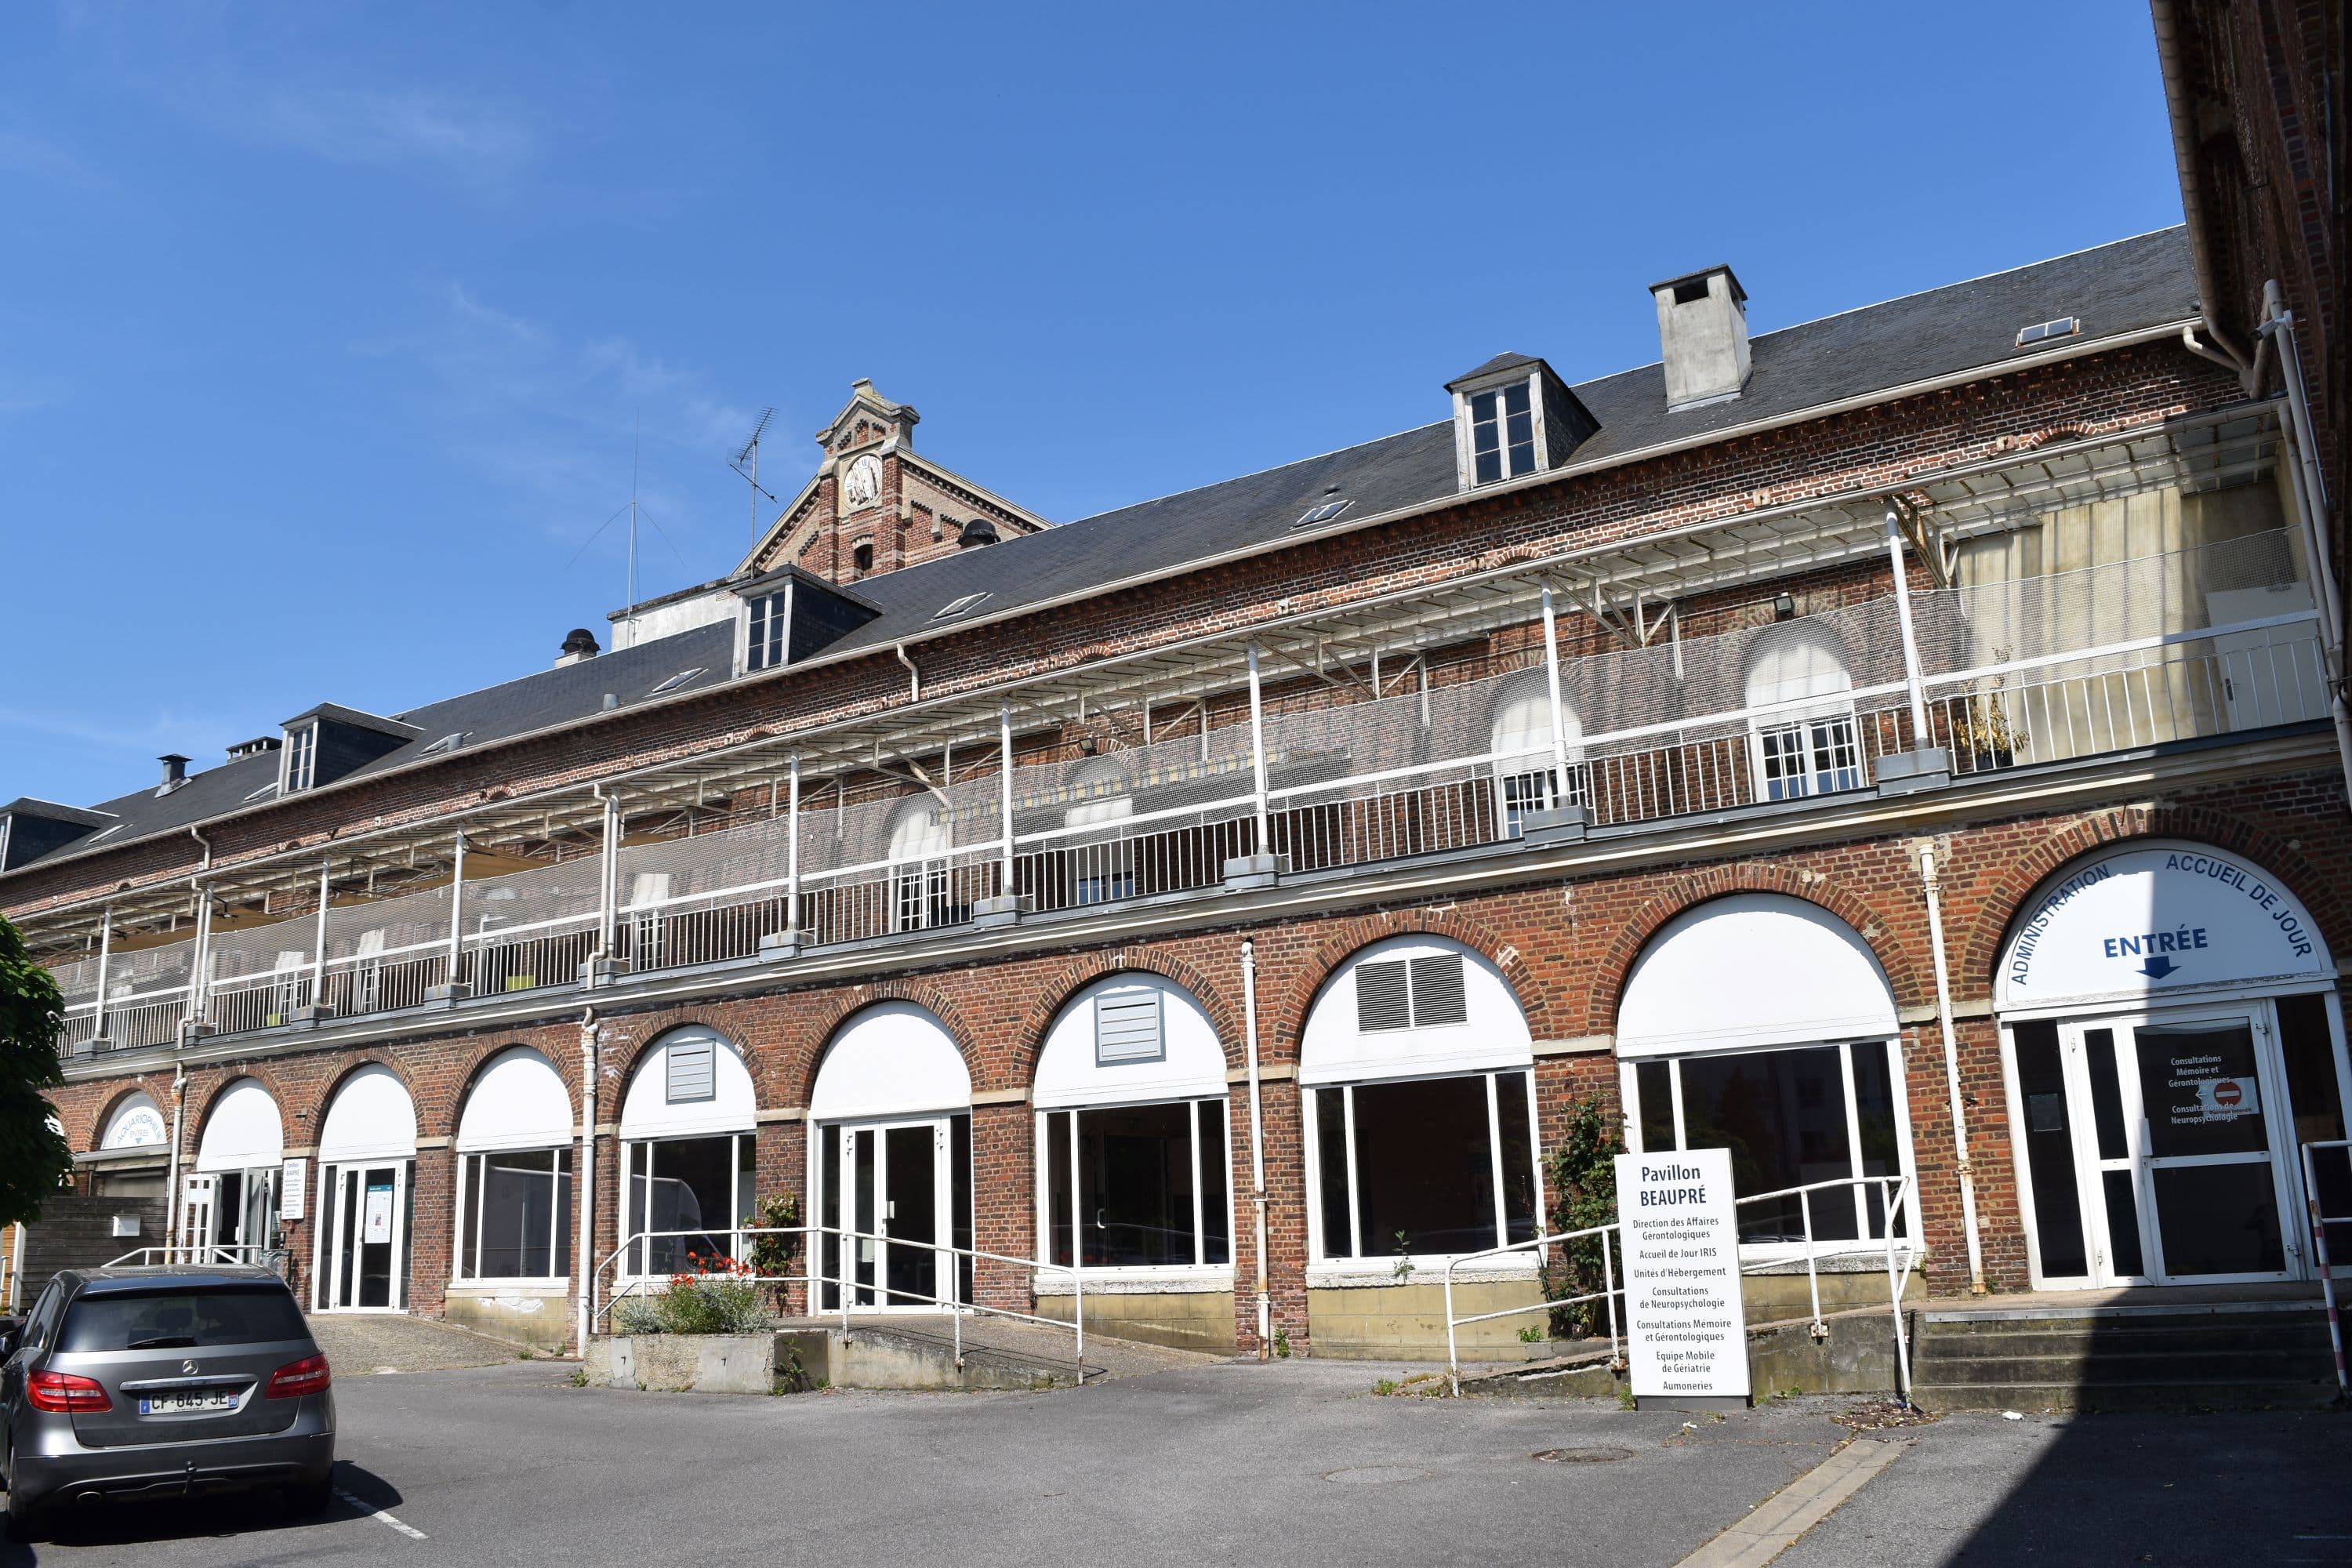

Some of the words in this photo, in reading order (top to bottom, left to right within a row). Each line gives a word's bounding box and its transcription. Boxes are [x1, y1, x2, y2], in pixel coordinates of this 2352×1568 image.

[2165, 854, 2247, 892] ACCUEIL
[2249, 884, 2278, 911] DE
[2272, 909, 2312, 958] JOUR
[2011, 864, 2111, 985] ADMINISTRATION
[2103, 924, 2208, 958] ENTRÉE
[2171, 1054, 2222, 1065] Consultations
[2176, 1066, 2209, 1076] Mémoire
[2169, 1076, 2230, 1087] Gérontologiques
[2172, 1104, 2223, 1113] Consultations
[2171, 1113, 2238, 1124] Neuropsychologie
[1642, 1164, 1700, 1181] Pavillon
[1640, 1185, 1707, 1206] BEAUPRÉ
[1633, 1218, 1668, 1229] Direction
[1671, 1218, 1685, 1227] des
[1686, 1217, 1719, 1226] Affaires
[1642, 1229, 1710, 1241] Gérontologiques
[1639, 1249, 1667, 1259] Accueil
[1668, 1249, 1679, 1258] de
[1680, 1248, 1698, 1258] Jour
[1700, 1247, 1717, 1257] IRIS
[1634, 1269, 1659, 1278] Unités
[1652, 1287, 1708, 1296] Consultations
[1639, 1300, 1650, 1308] de
[1651, 1298, 1725, 1310] Neuropsychologie
[1637, 1319, 1691, 1329] Consultations
[1693, 1319, 1732, 1328] Mémoire
[1655, 1332, 1725, 1343] Gérontologiques
[1657, 1351, 1684, 1362] Equipe
[1686, 1350, 1715, 1360] Mobile
[1662, 1363, 1672, 1373] de
[1674, 1363, 1711, 1373] Gériatrie
[1663, 1381, 1713, 1390] Aumoneries
